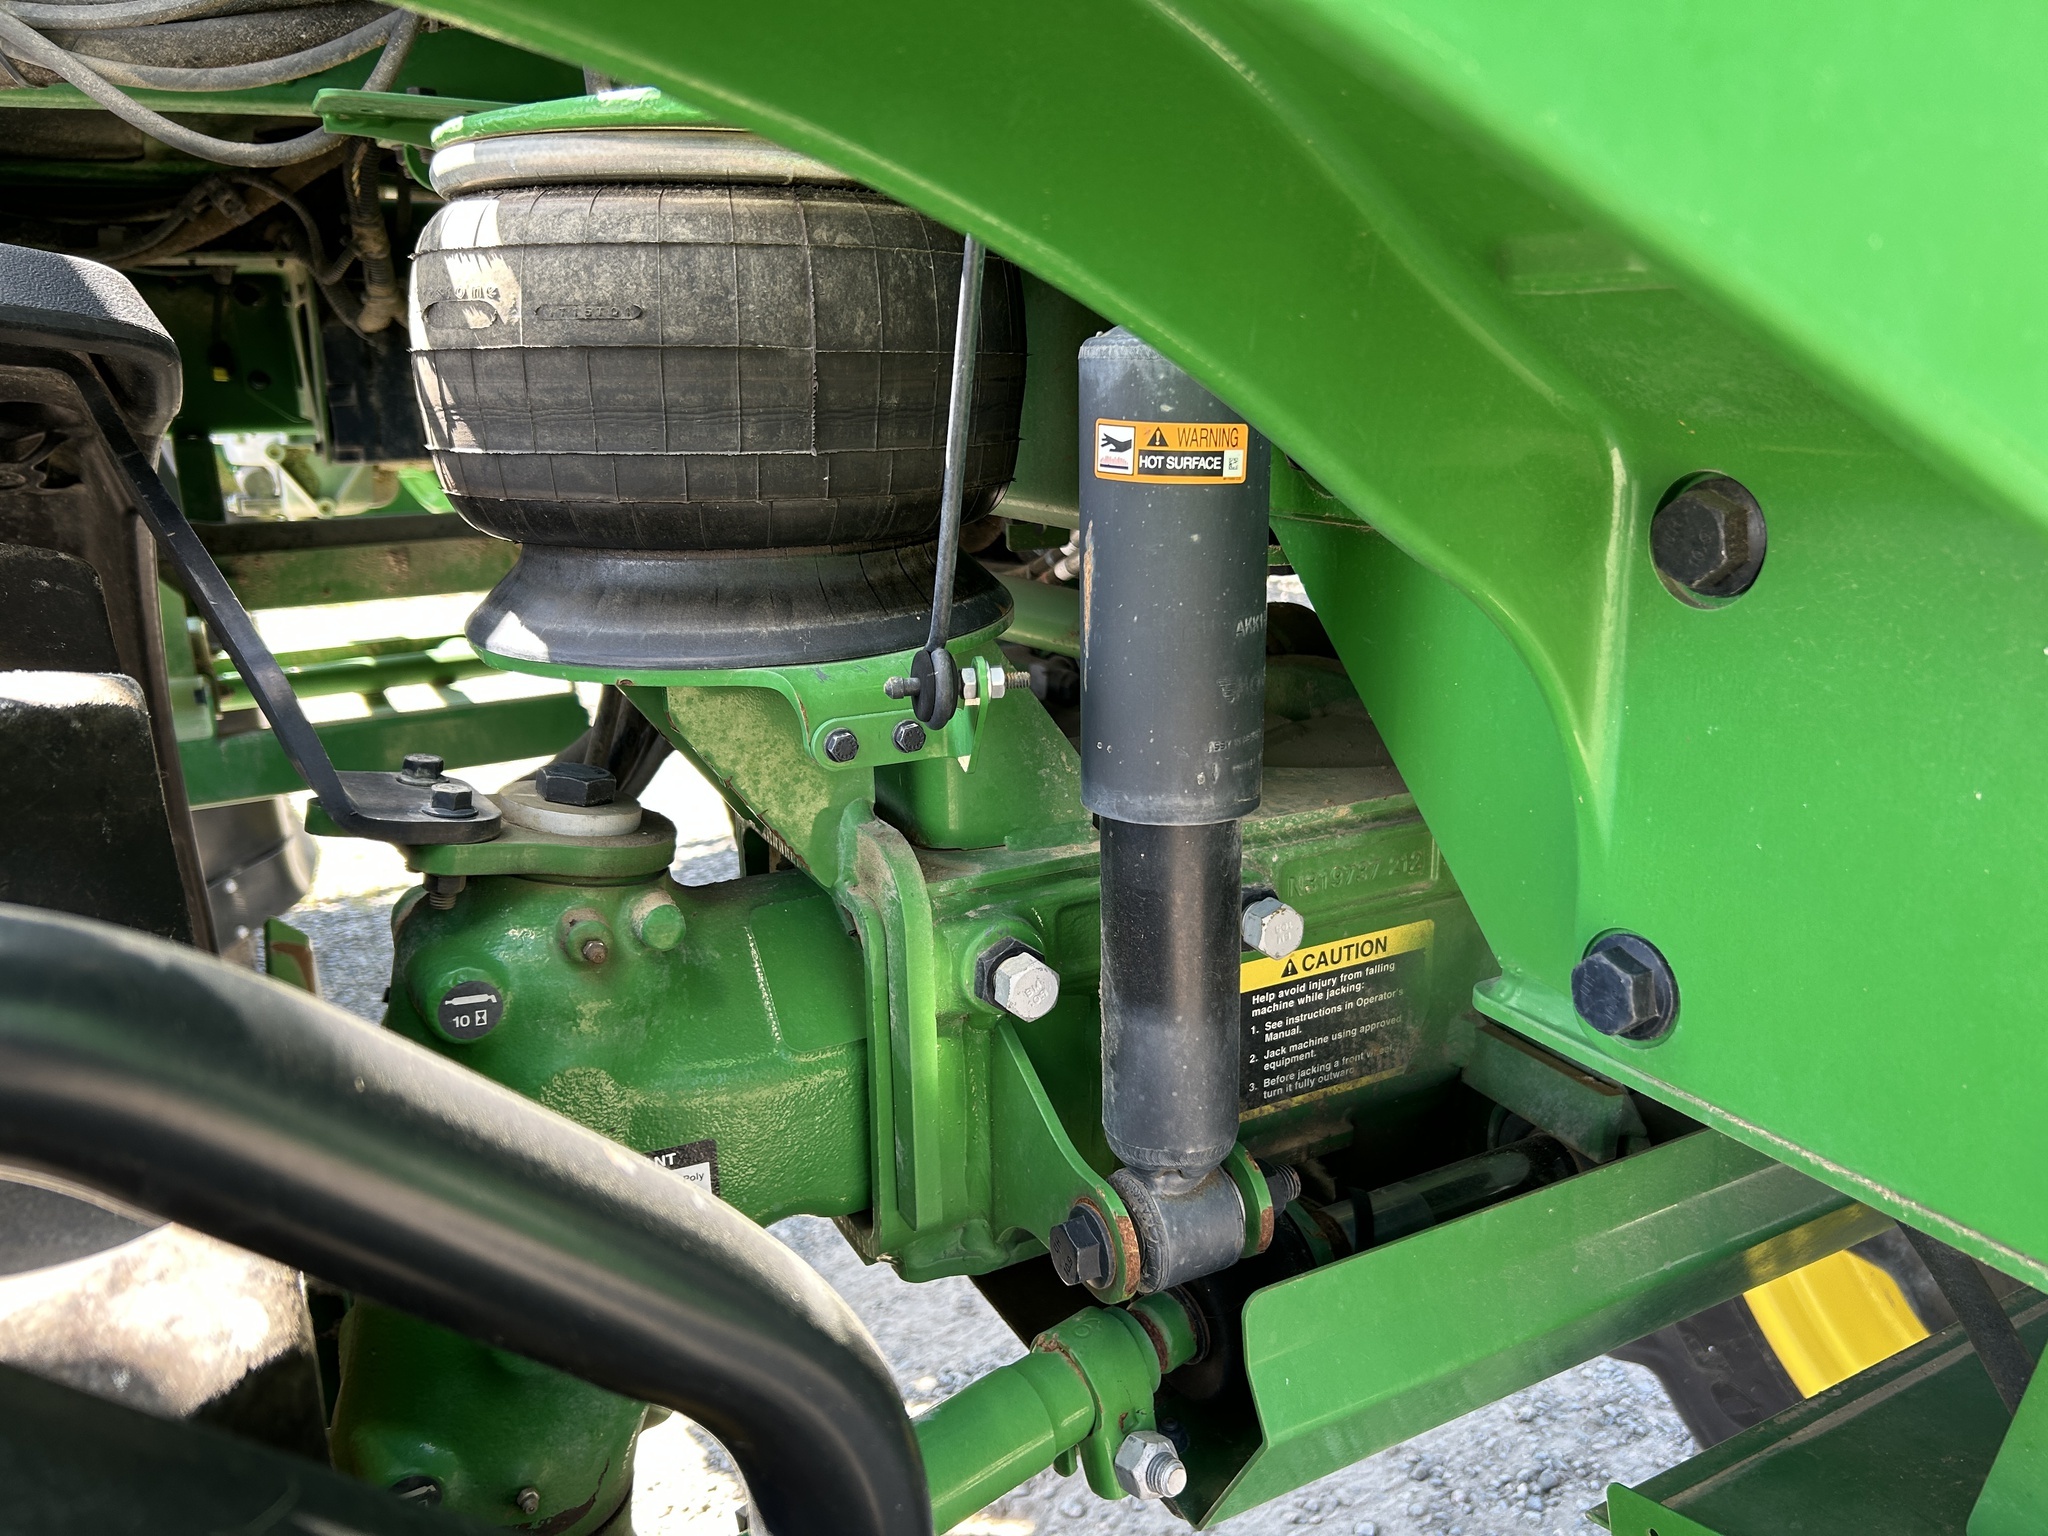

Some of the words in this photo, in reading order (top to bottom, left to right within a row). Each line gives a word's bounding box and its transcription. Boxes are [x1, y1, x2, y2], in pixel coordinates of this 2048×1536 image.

[1177, 427, 1239, 448] WARNING
[1139, 456, 1164, 469] HOT
[1166, 456, 1222, 470] SURFACE
[1302, 936, 1387, 972] CAUTION
[1252, 993, 1275, 1005] Help
[1278, 983, 1306, 998] avoid
[1309, 975, 1337, 991] injury
[1340, 971, 1362, 982] from
[1366, 962, 1395, 976] falling
[1251, 1026, 1259, 1035] 1.
[1265, 1020, 1283, 1031] See
[1285, 1004, 1342, 1025] instructions
[1345, 1001, 1354, 1010] in
[1356, 989, 1404, 1007] Operator's
[1252, 1000, 1294, 1017] machine
[1297, 992, 1323, 1005] while
[1325, 982, 1365, 1001] jacking:
[452, 1015, 470, 1028] 10
[1265, 1026, 1302, 1043] Manual.
[1250, 1054, 1258, 1063] 2.
[1264, 1047, 1286, 1060] Jack
[1289, 1035, 1329, 1053] machine
[1332, 1026, 1357, 1041] using
[1359, 1015, 1402, 1034] approved
[1249, 1083, 1258, 1091] 3.
[1264, 1073, 1294, 1088] Before
[1297, 1062, 1331, 1079] jacking
[1342, 1054, 1364, 1068] front
[1264, 1051, 1316, 1071] equipment.
[1264, 1088, 1282, 1099] turn
[1286, 1083, 1292, 1094] it
[1295, 1078, 1315, 1091] fully
